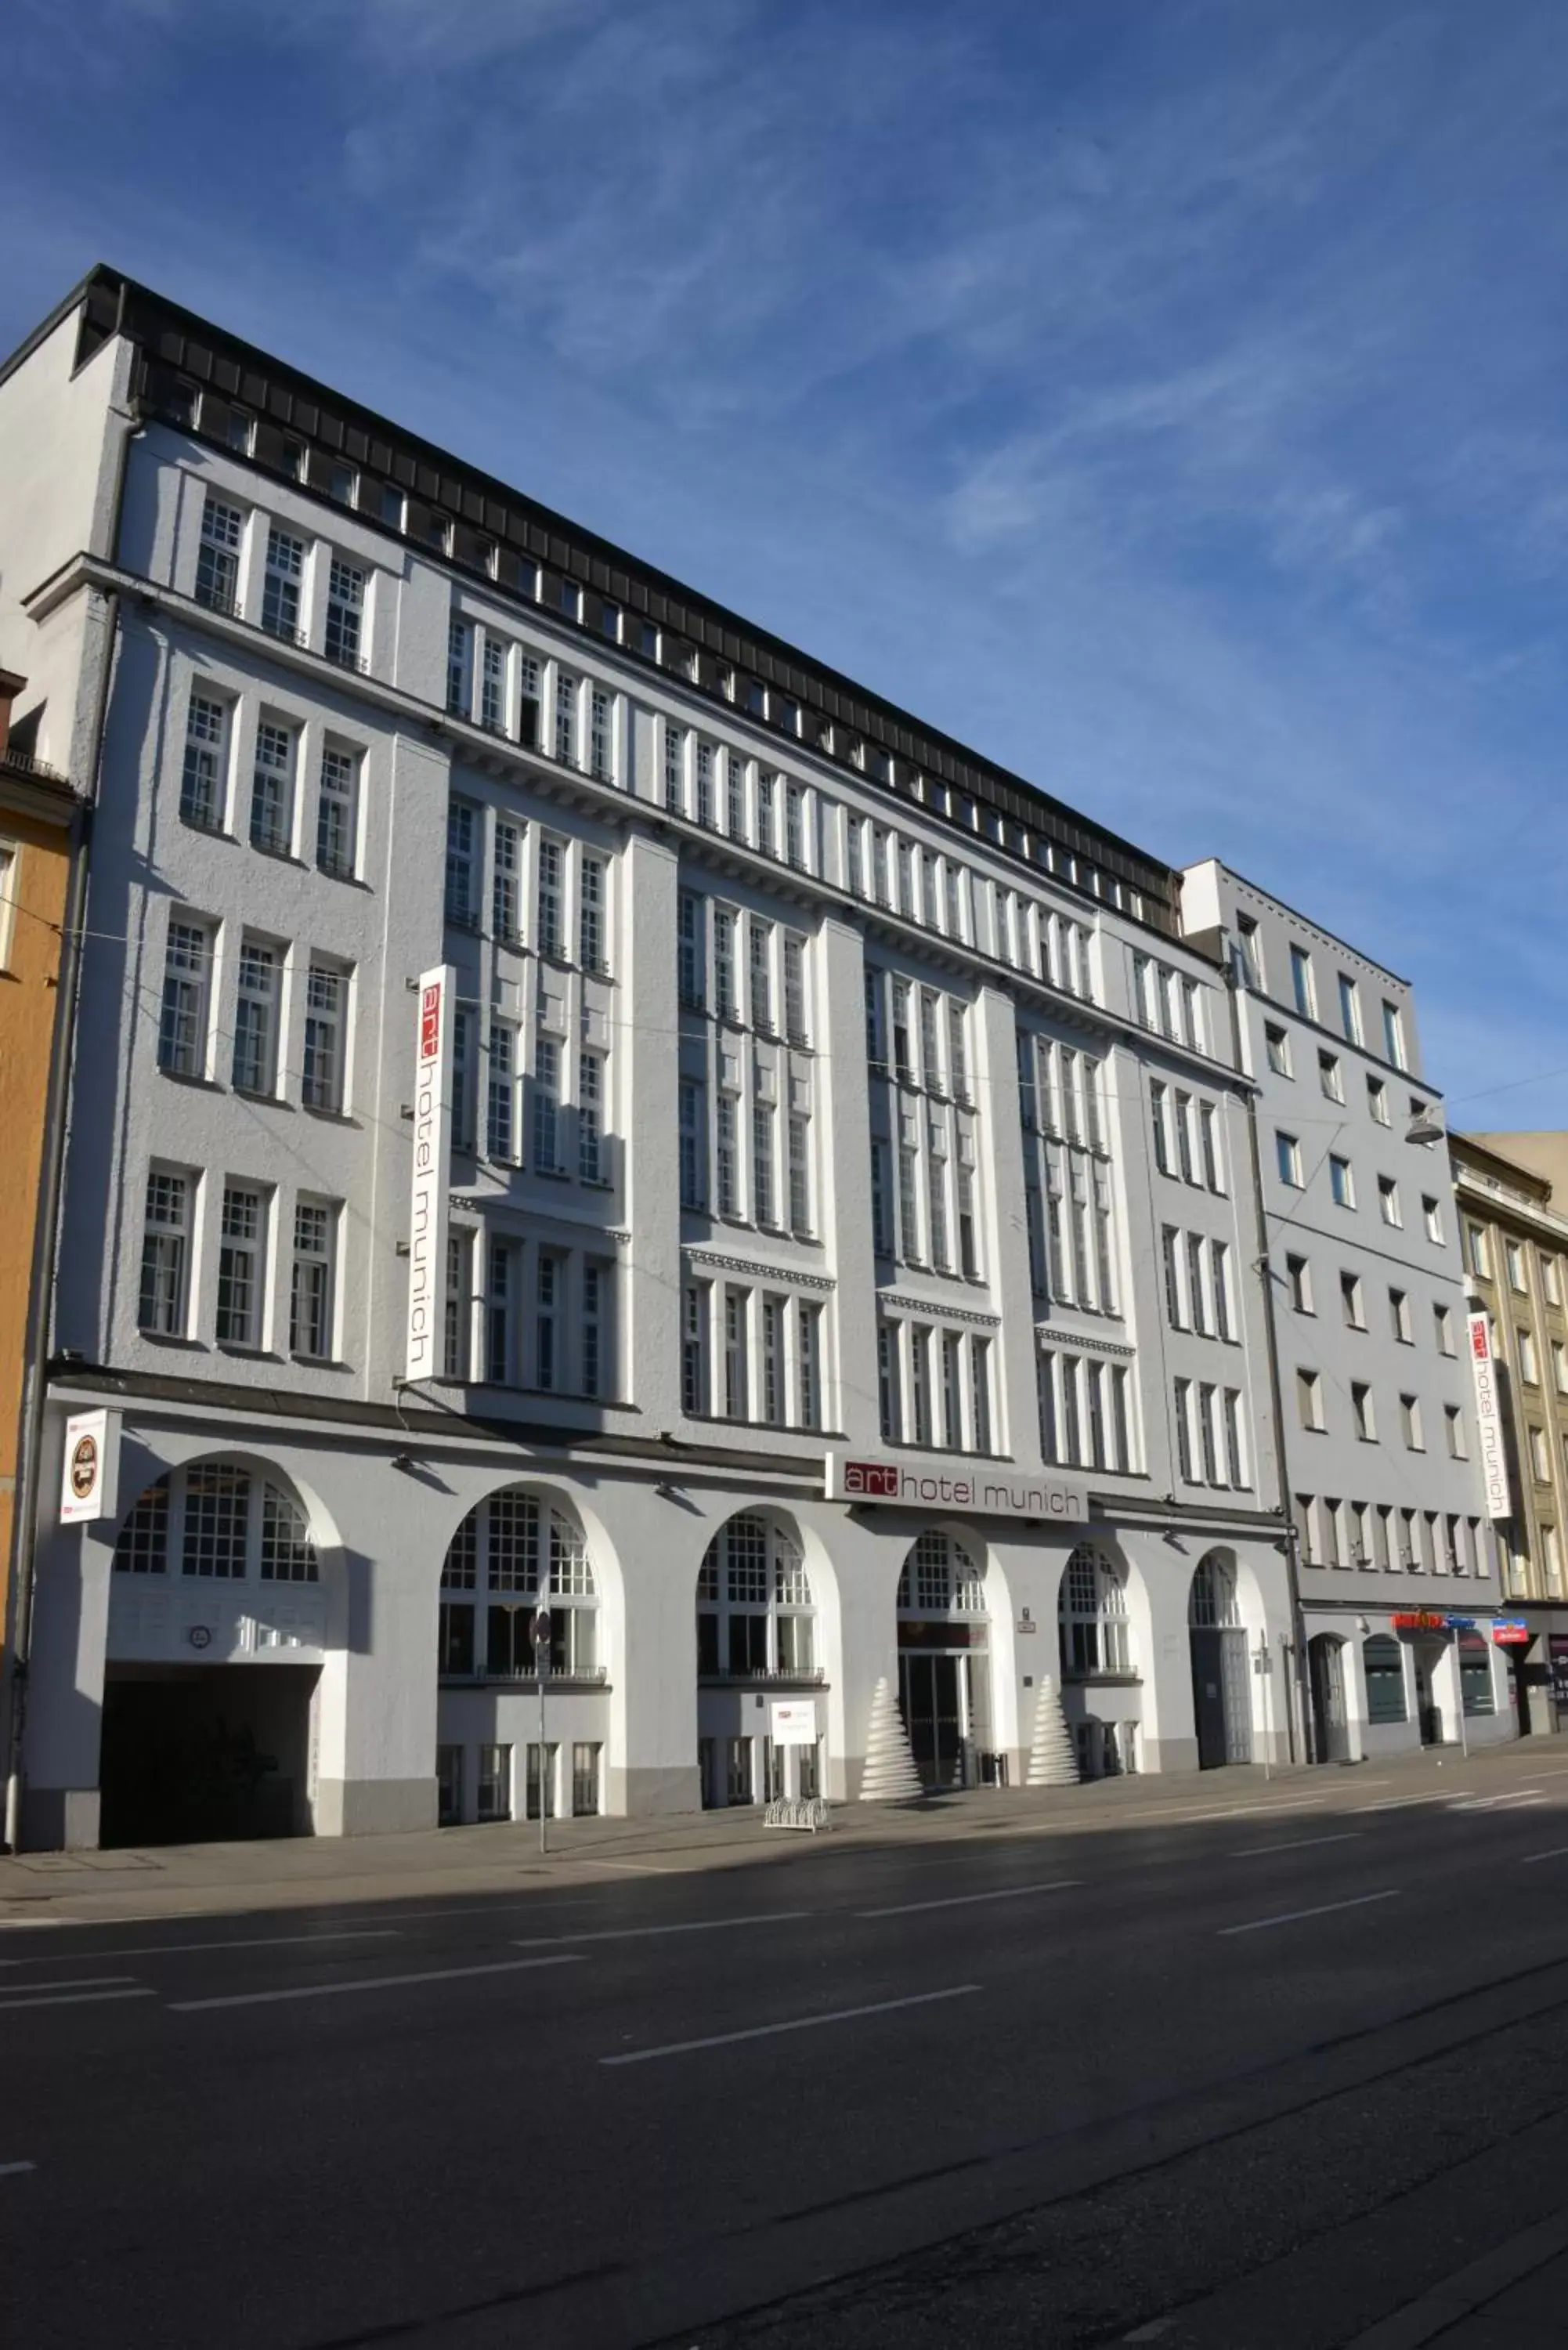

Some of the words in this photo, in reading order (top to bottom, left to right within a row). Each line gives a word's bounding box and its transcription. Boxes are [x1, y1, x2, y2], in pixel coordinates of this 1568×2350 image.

[411, 1190, 430, 1363] munich
[985, 1484, 1080, 1516] munich
[1483, 1426, 1505, 1511] munich
